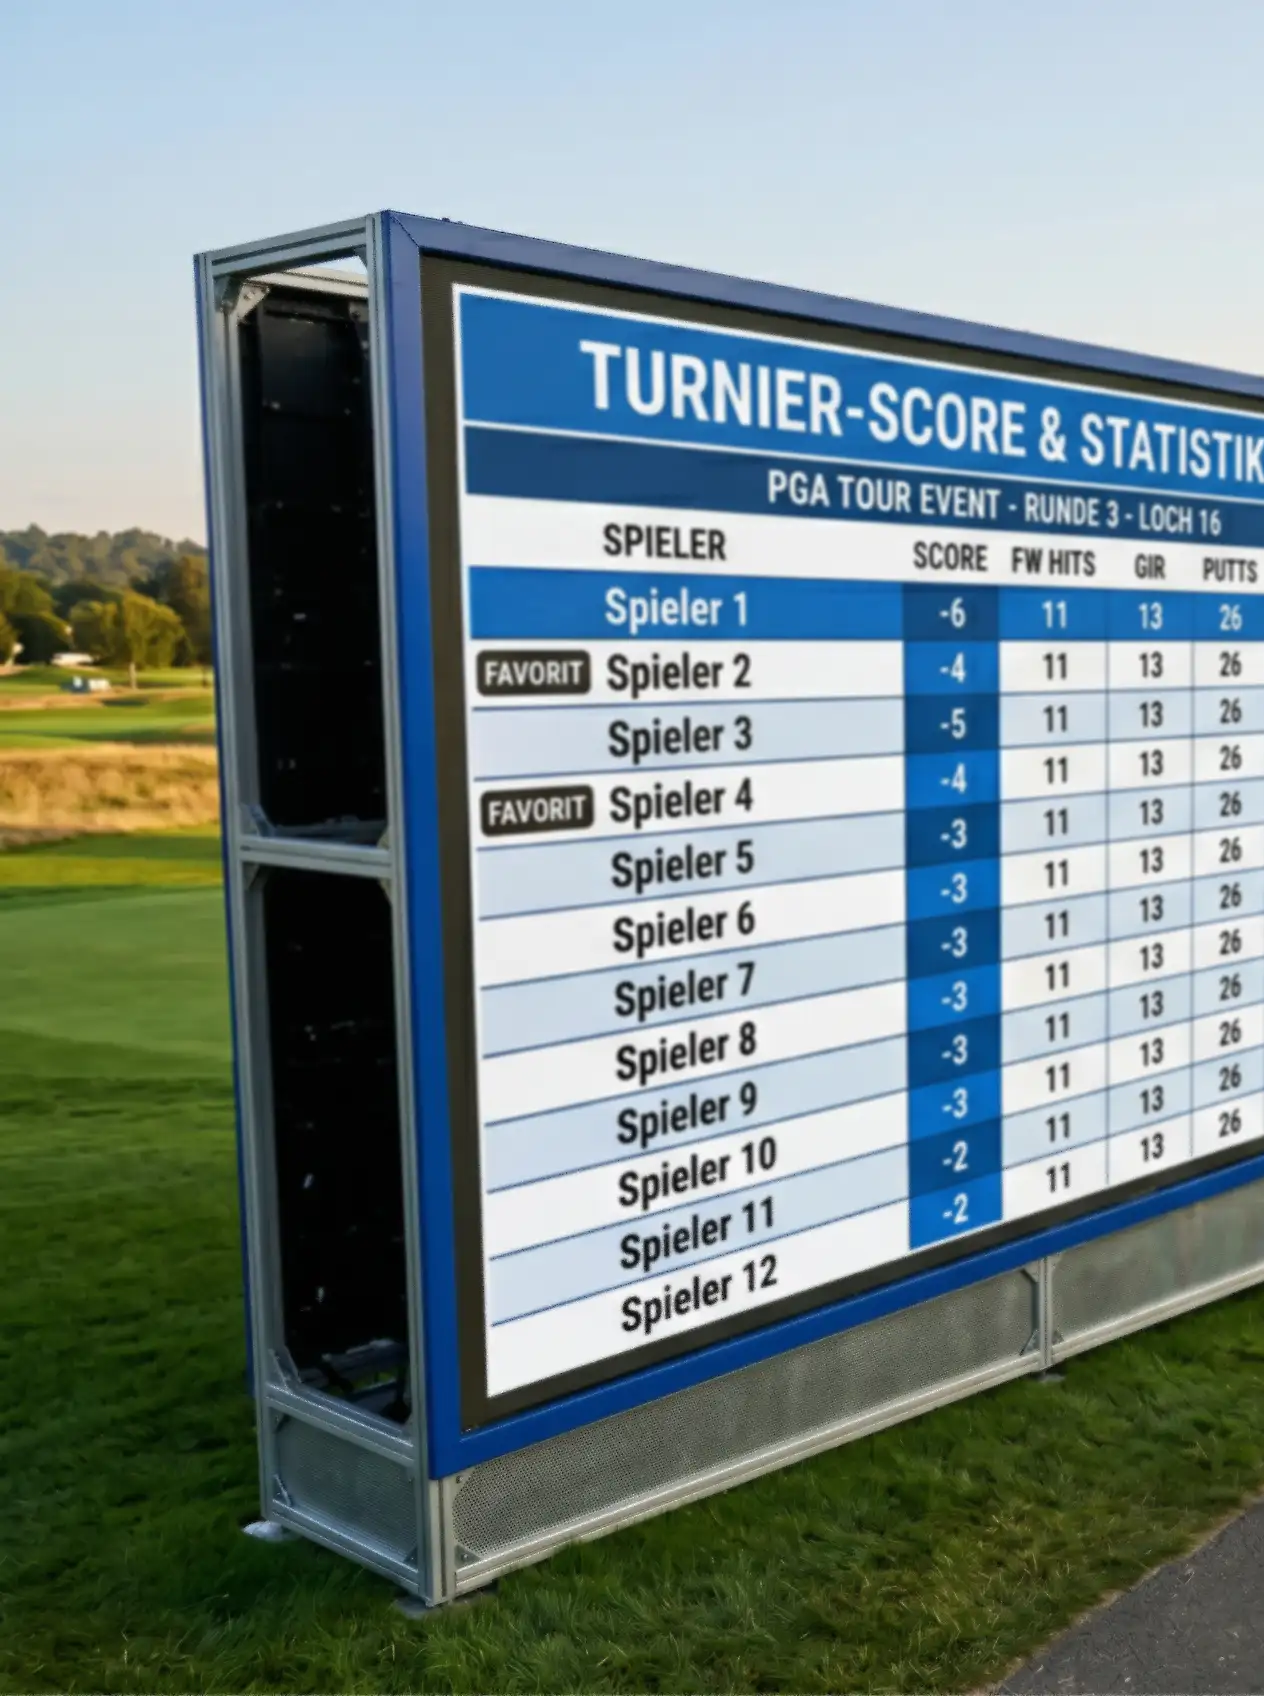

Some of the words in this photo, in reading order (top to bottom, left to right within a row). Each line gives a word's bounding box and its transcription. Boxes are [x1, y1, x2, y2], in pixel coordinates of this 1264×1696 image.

[579, 340, 1026, 457] TURNIER-SCORE
[1039, 406, 1067, 462] &
[603, 522, 726, 561] SPIELER
[913, 540, 988, 572] SCORE
[1011, 546, 1043, 574] FW
[1048, 549, 1096, 577] HITS
[1134, 553, 1166, 580] GIR
[1202, 557, 1258, 584] PUTTS
[768, 469, 830, 507] PGA
[837, 475, 911, 513] TOUR
[920, 482, 1001, 519] EVENT
[1024, 492, 1100, 527] RUNDE
[1106, 500, 1119, 528] 3
[1139, 503, 1193, 534] LOCH
[1199, 509, 1222, 536] 16
[605, 587, 723, 635] Spieler
[733, 591, 747, 626] 1
[940, 597, 966, 628] -6
[1042, 600, 1067, 628] 11
[1138, 601, 1163, 630] 13
[1219, 603, 1242, 631] 26
[484, 659, 584, 687] FAVORIT
[607, 651, 724, 700] Spieler
[733, 652, 751, 688] 2
[940, 653, 966, 683] -4
[1043, 652, 1067, 680] 11
[1139, 650, 1164, 679] 13
[1219, 651, 1242, 678] 26
[608, 716, 725, 766] Spieler
[734, 715, 753, 751] 3
[940, 707, 966, 739] -5
[1043, 704, 1068, 733] 11
[1139, 700, 1164, 728] 13
[1220, 698, 1242, 725] 26
[487, 793, 587, 827] FAVORIT
[609, 780, 726, 830] Spieler
[734, 777, 754, 812] 4
[941, 763, 967, 793] -4
[1044, 756, 1068, 784] 11
[1139, 749, 1164, 777] 13
[1219, 744, 1242, 771] 26
[611, 844, 727, 895] Spieler
[736, 839, 755, 874] 5
[940, 818, 967, 849] -3
[1044, 808, 1068, 837] 11
[1139, 798, 1164, 826] 13
[1219, 791, 1242, 818] 26
[613, 906, 728, 959] Spieler
[737, 900, 756, 936] 6
[940, 872, 968, 904] -3
[1044, 859, 1068, 888] 11
[1139, 846, 1164, 874] 13
[1219, 836, 1242, 864] 26
[615, 969, 728, 1023] Spieler
[737, 960, 756, 996] 7
[941, 926, 968, 958] -3
[1045, 909, 1069, 939] 11
[1140, 894, 1164, 923] 13
[1220, 882, 1242, 910] 26
[616, 1031, 730, 1087] Spieler
[739, 1020, 757, 1057] 8
[941, 980, 968, 1012] -3
[1045, 961, 1069, 991] 11
[1139, 942, 1164, 971] 13
[1219, 928, 1242, 956] 26
[617, 1093, 731, 1150] Spieler
[739, 1081, 758, 1116] 9
[942, 1034, 968, 1066] -3
[1045, 1012, 1069, 1042] 11
[1140, 990, 1164, 1019] 13
[1219, 973, 1242, 1001] 26
[618, 1153, 731, 1212] Spieler
[741, 1136, 777, 1175] 10
[942, 1087, 968, 1119] -3
[1046, 1062, 1070, 1092] 11
[1140, 1037, 1164, 1067] 13
[1219, 1019, 1242, 1047] 26
[620, 1214, 732, 1273] Spieler
[742, 1196, 773, 1234] 11
[943, 1140, 968, 1172] -2
[1046, 1112, 1070, 1143] 11
[1140, 1085, 1164, 1114] 13
[1219, 1063, 1242, 1092] 26
[621, 1274, 733, 1335] Spieler
[743, 1254, 778, 1293] 12
[943, 1192, 969, 1225] -2
[1046, 1161, 1070, 1193] 11
[1140, 1132, 1164, 1162] 13
[1219, 1108, 1242, 1138] 26
